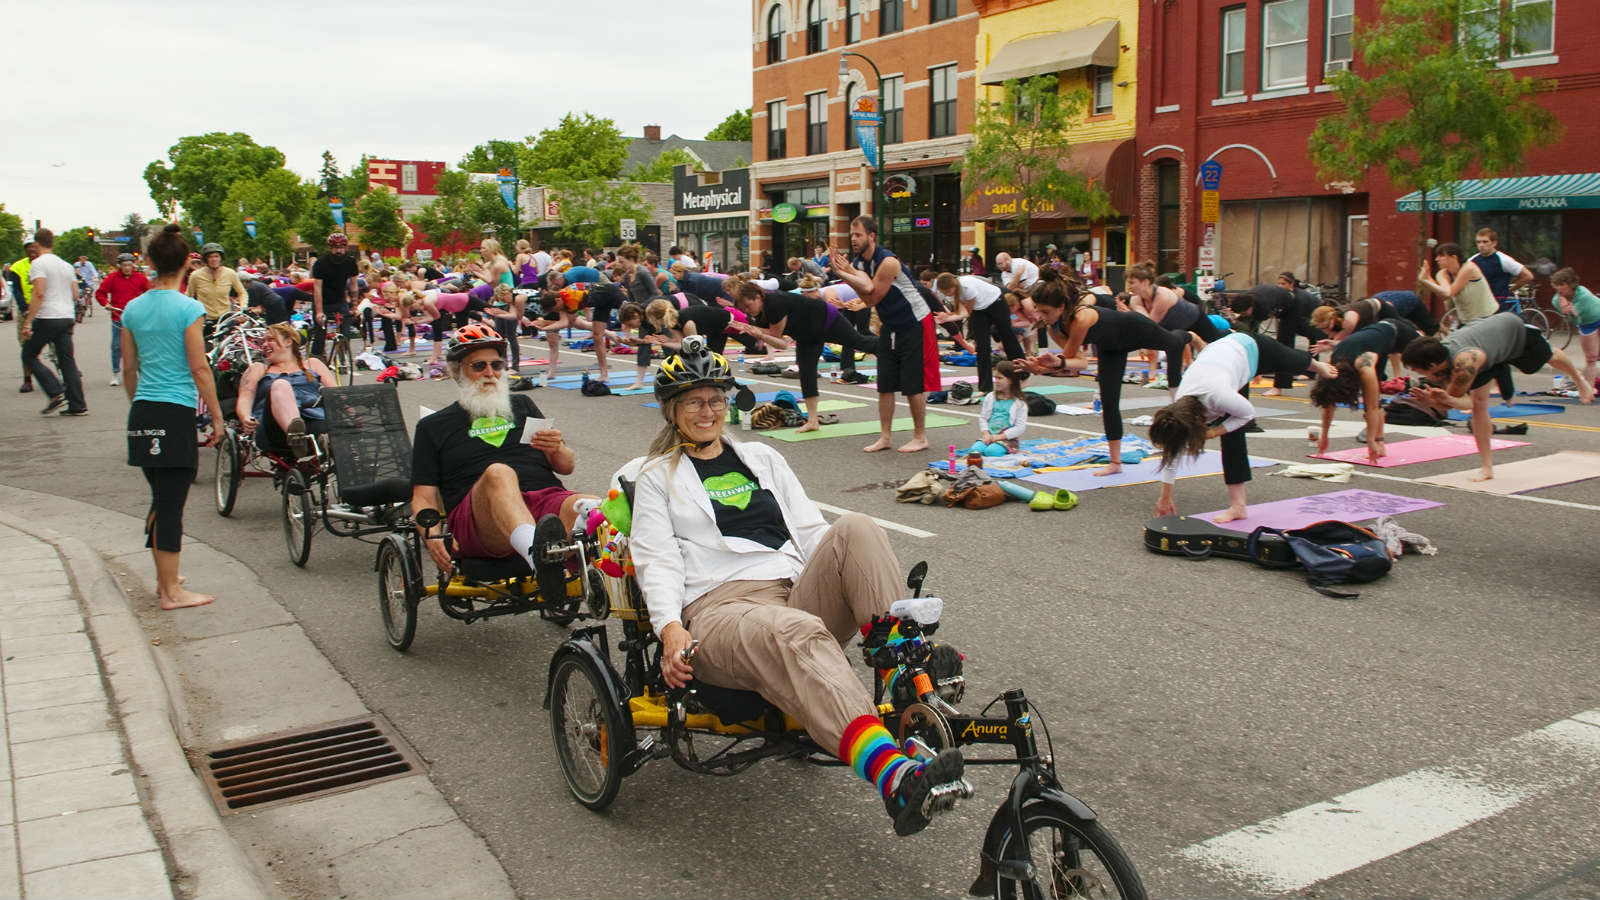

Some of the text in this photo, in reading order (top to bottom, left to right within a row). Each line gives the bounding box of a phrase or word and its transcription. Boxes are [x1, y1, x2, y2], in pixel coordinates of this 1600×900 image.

[1206, 170, 1217, 182] 22
[682, 186, 742, 210] Metaphysical
[1518, 198, 1568, 208] MOUSAKA
[992, 198, 1017, 214] and
[1429, 201, 1467, 211] CHICKEN
[623, 229, 636, 238] 30
[469, 422, 515, 438] GREENWAY
[961, 720, 1008, 738] Anura
